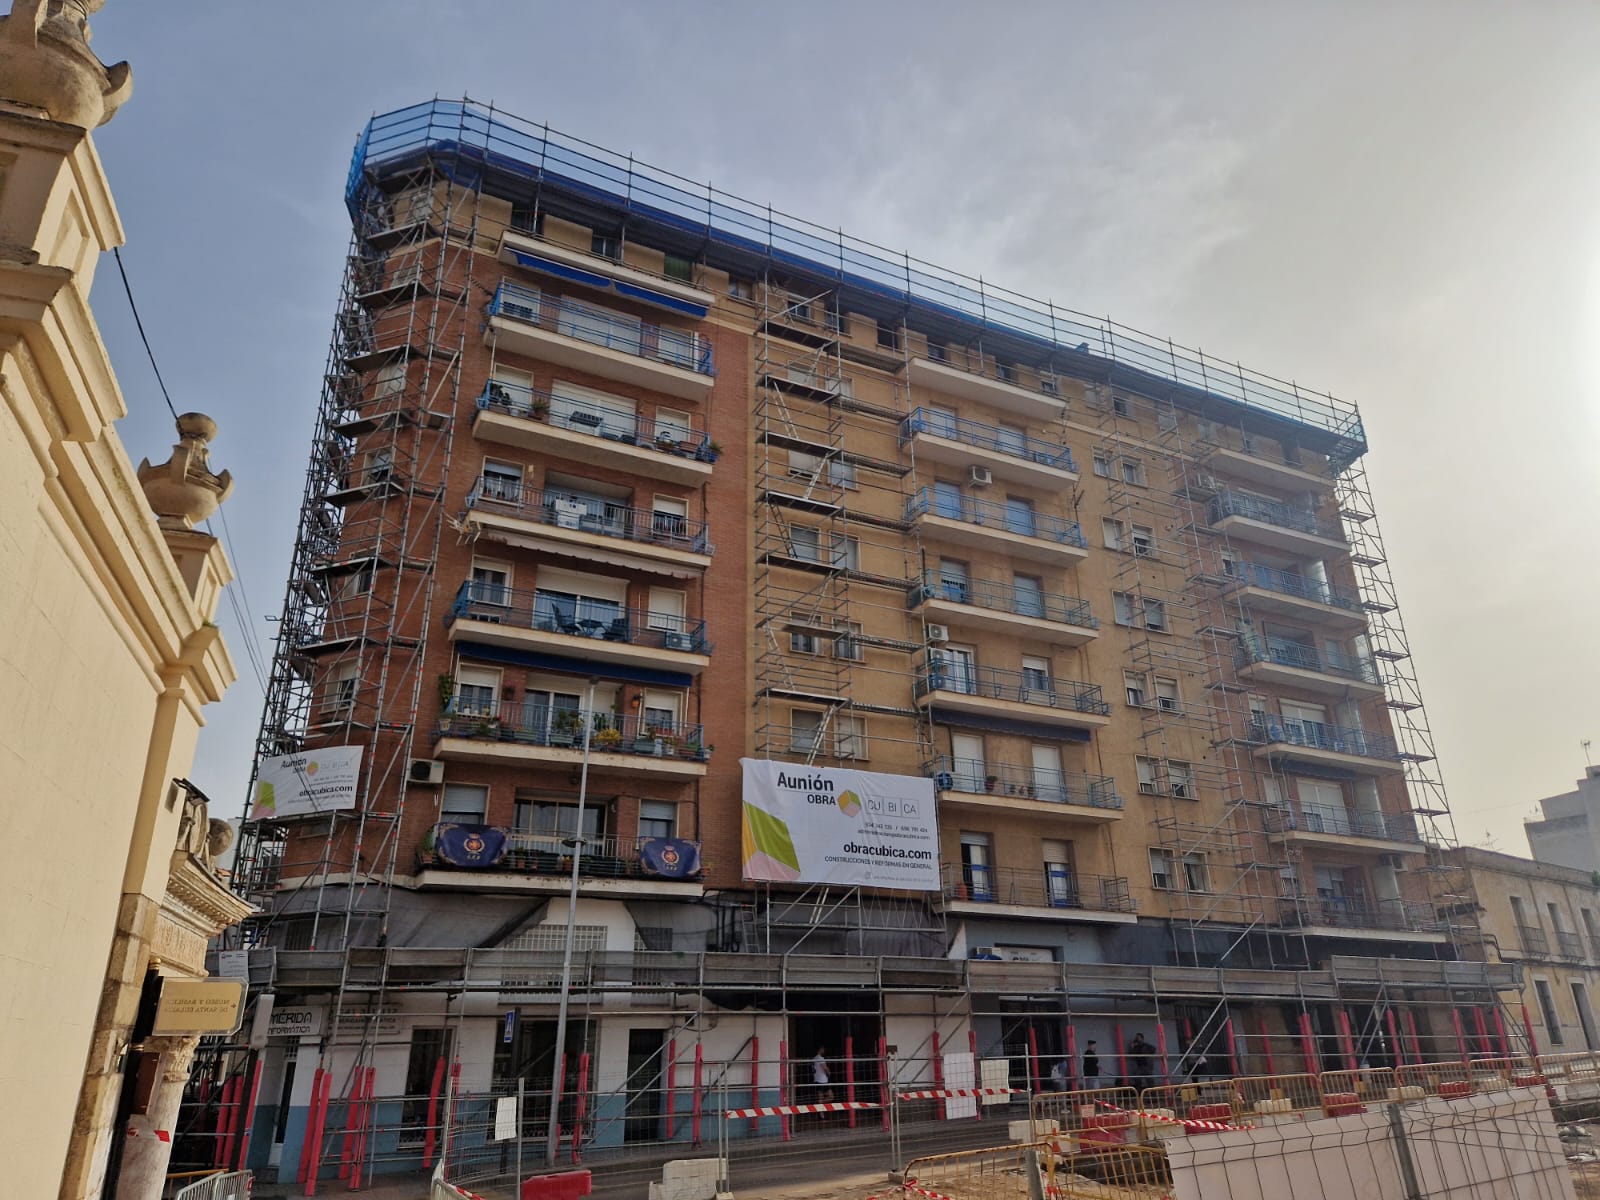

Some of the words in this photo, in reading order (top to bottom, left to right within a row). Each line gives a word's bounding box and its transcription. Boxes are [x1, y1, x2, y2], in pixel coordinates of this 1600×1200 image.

[777, 771, 834, 791] Aunión
[807, 793, 836, 806] OBRA
[843, 842, 932, 860] obracubica.com
[824, 855, 871, 865] CONSTRUCCIONES
[270, 1009, 312, 1024] MÉRIDA
[267, 1025, 311, 1035] NFORMÁTICA
